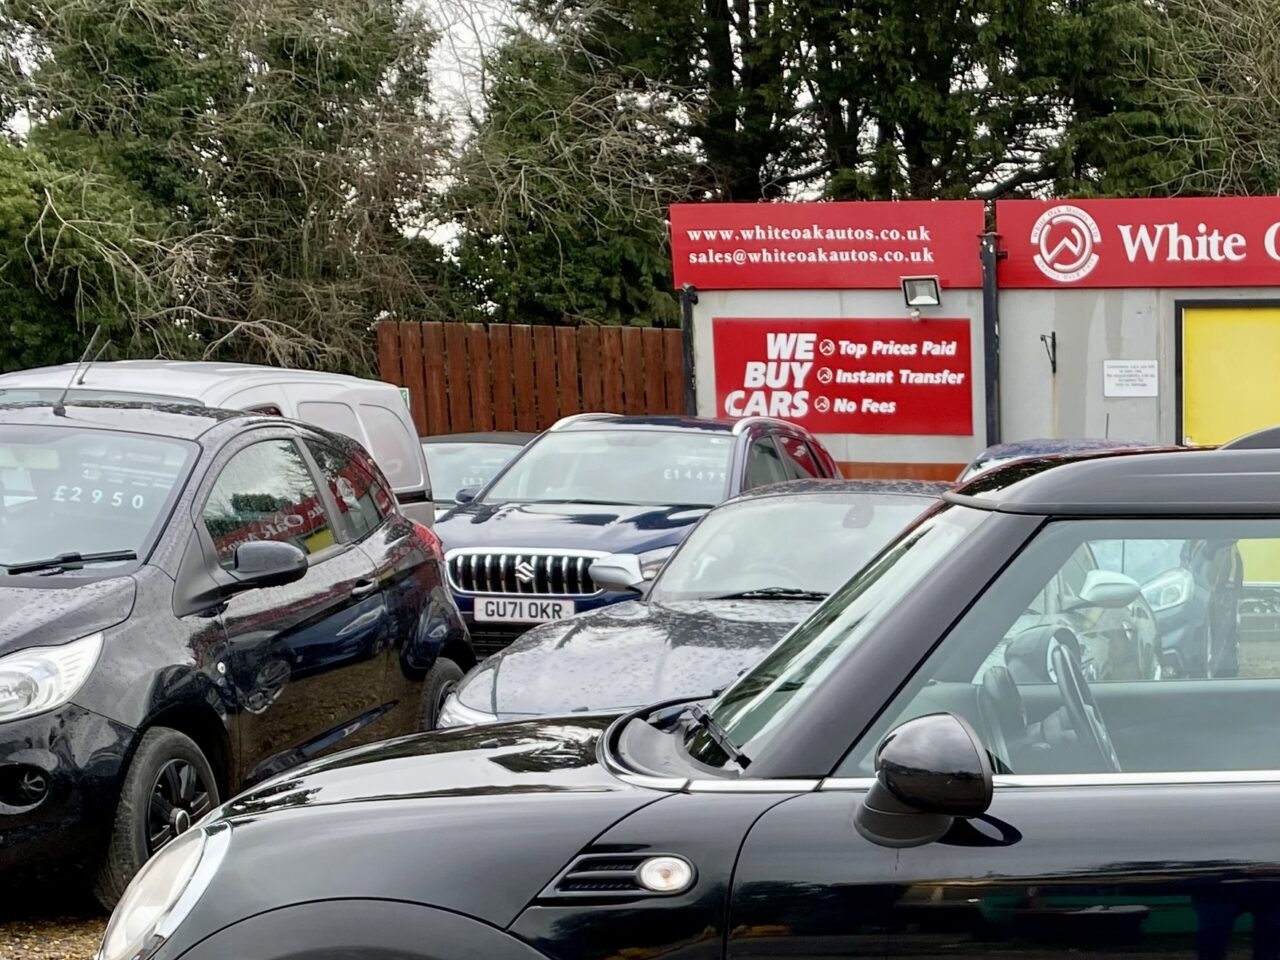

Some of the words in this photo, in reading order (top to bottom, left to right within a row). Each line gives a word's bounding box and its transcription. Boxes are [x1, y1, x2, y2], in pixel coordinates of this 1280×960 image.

[686, 224, 931, 242] www.whiteoakautos.co.uk
[1117, 222, 1247, 263] White
[689, 246, 935, 265] sales@whiteoakautos.co.uk
[766, 333, 817, 360] WE
[838, 341, 867, 359] Top
[871, 340, 918, 356] Prices
[921, 340, 958, 356] Paid
[743, 361, 814, 389] BUY
[835, 369, 894, 384] Instant
[899, 368, 965, 385] Transfer
[724, 390, 810, 418] CARS
[833, 398, 857, 413] No
[861, 398, 897, 414] Fees
[53, 485, 144, 509] £2950
[485, 600, 523, 618] GU71
[528, 602, 563, 619] OKR
